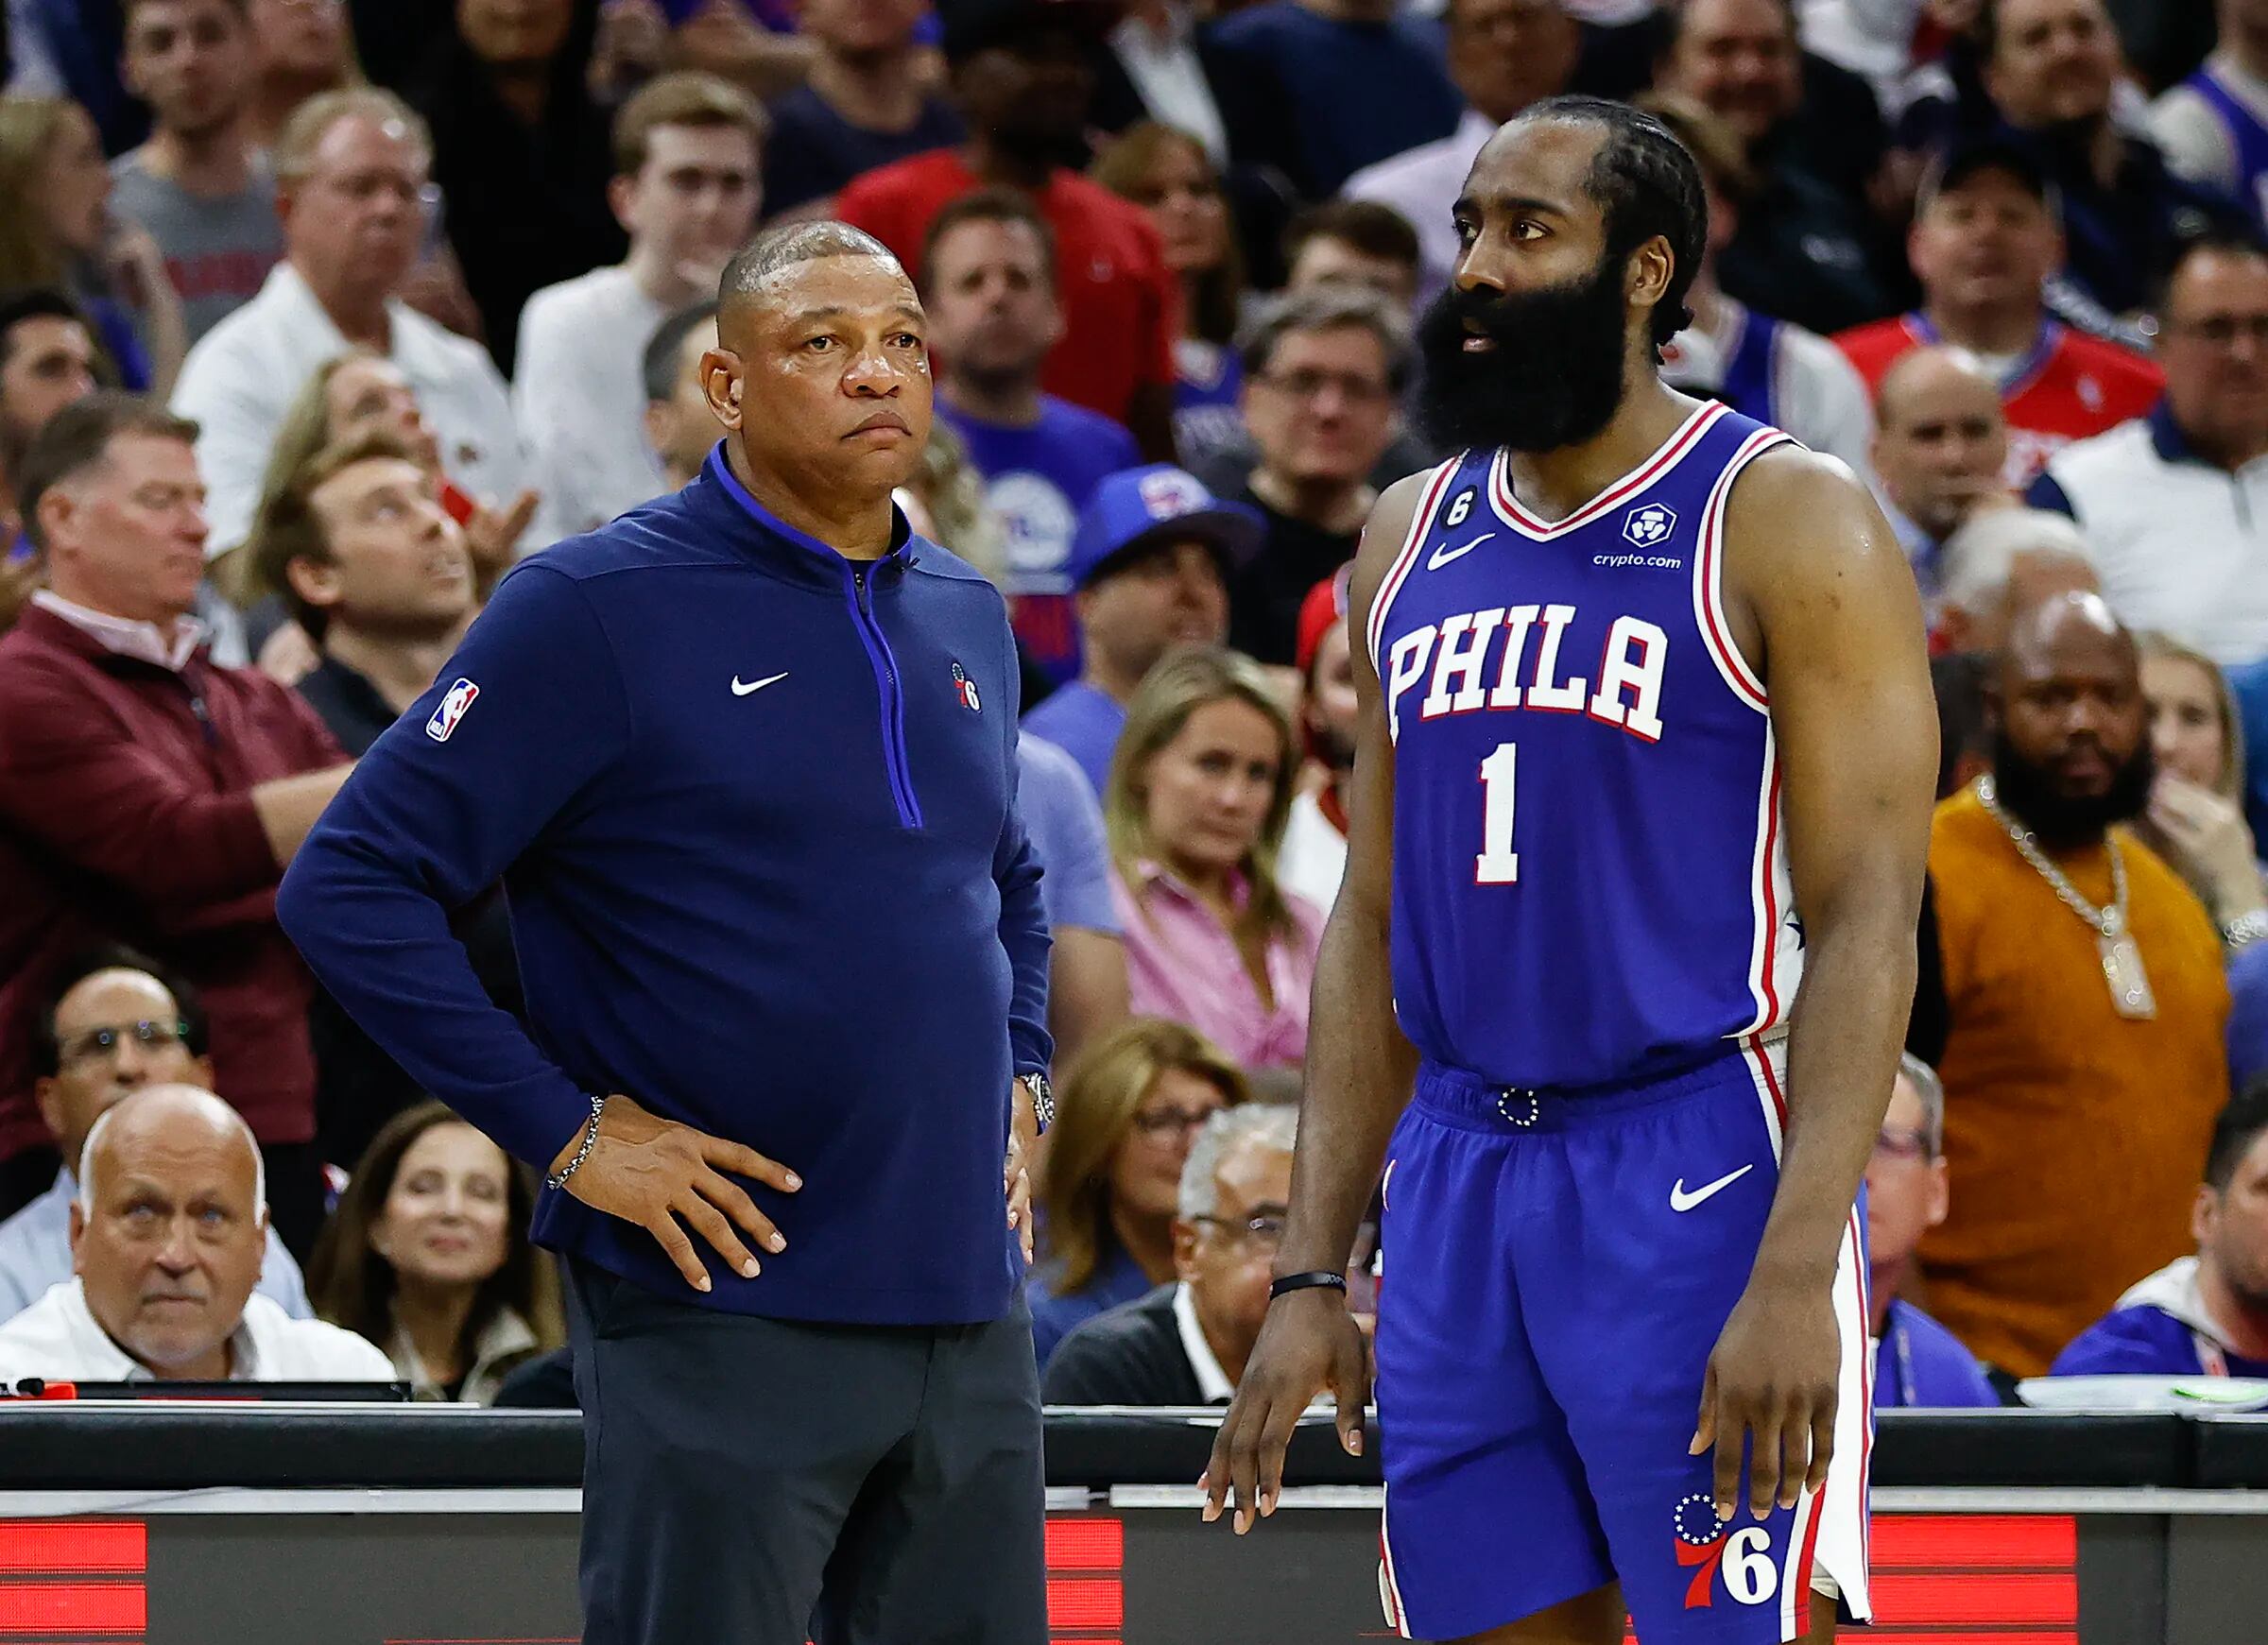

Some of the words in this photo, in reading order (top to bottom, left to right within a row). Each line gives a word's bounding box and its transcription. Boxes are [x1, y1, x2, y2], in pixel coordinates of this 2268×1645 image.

[1447, 490, 1473, 525] 6
[1593, 554, 1681, 569] crypto.com
[954, 680, 980, 711] 76
[1389, 604, 1668, 744] PHILA
[1474, 743, 1518, 885] 1
[1674, 1527, 1778, 1609] 76
